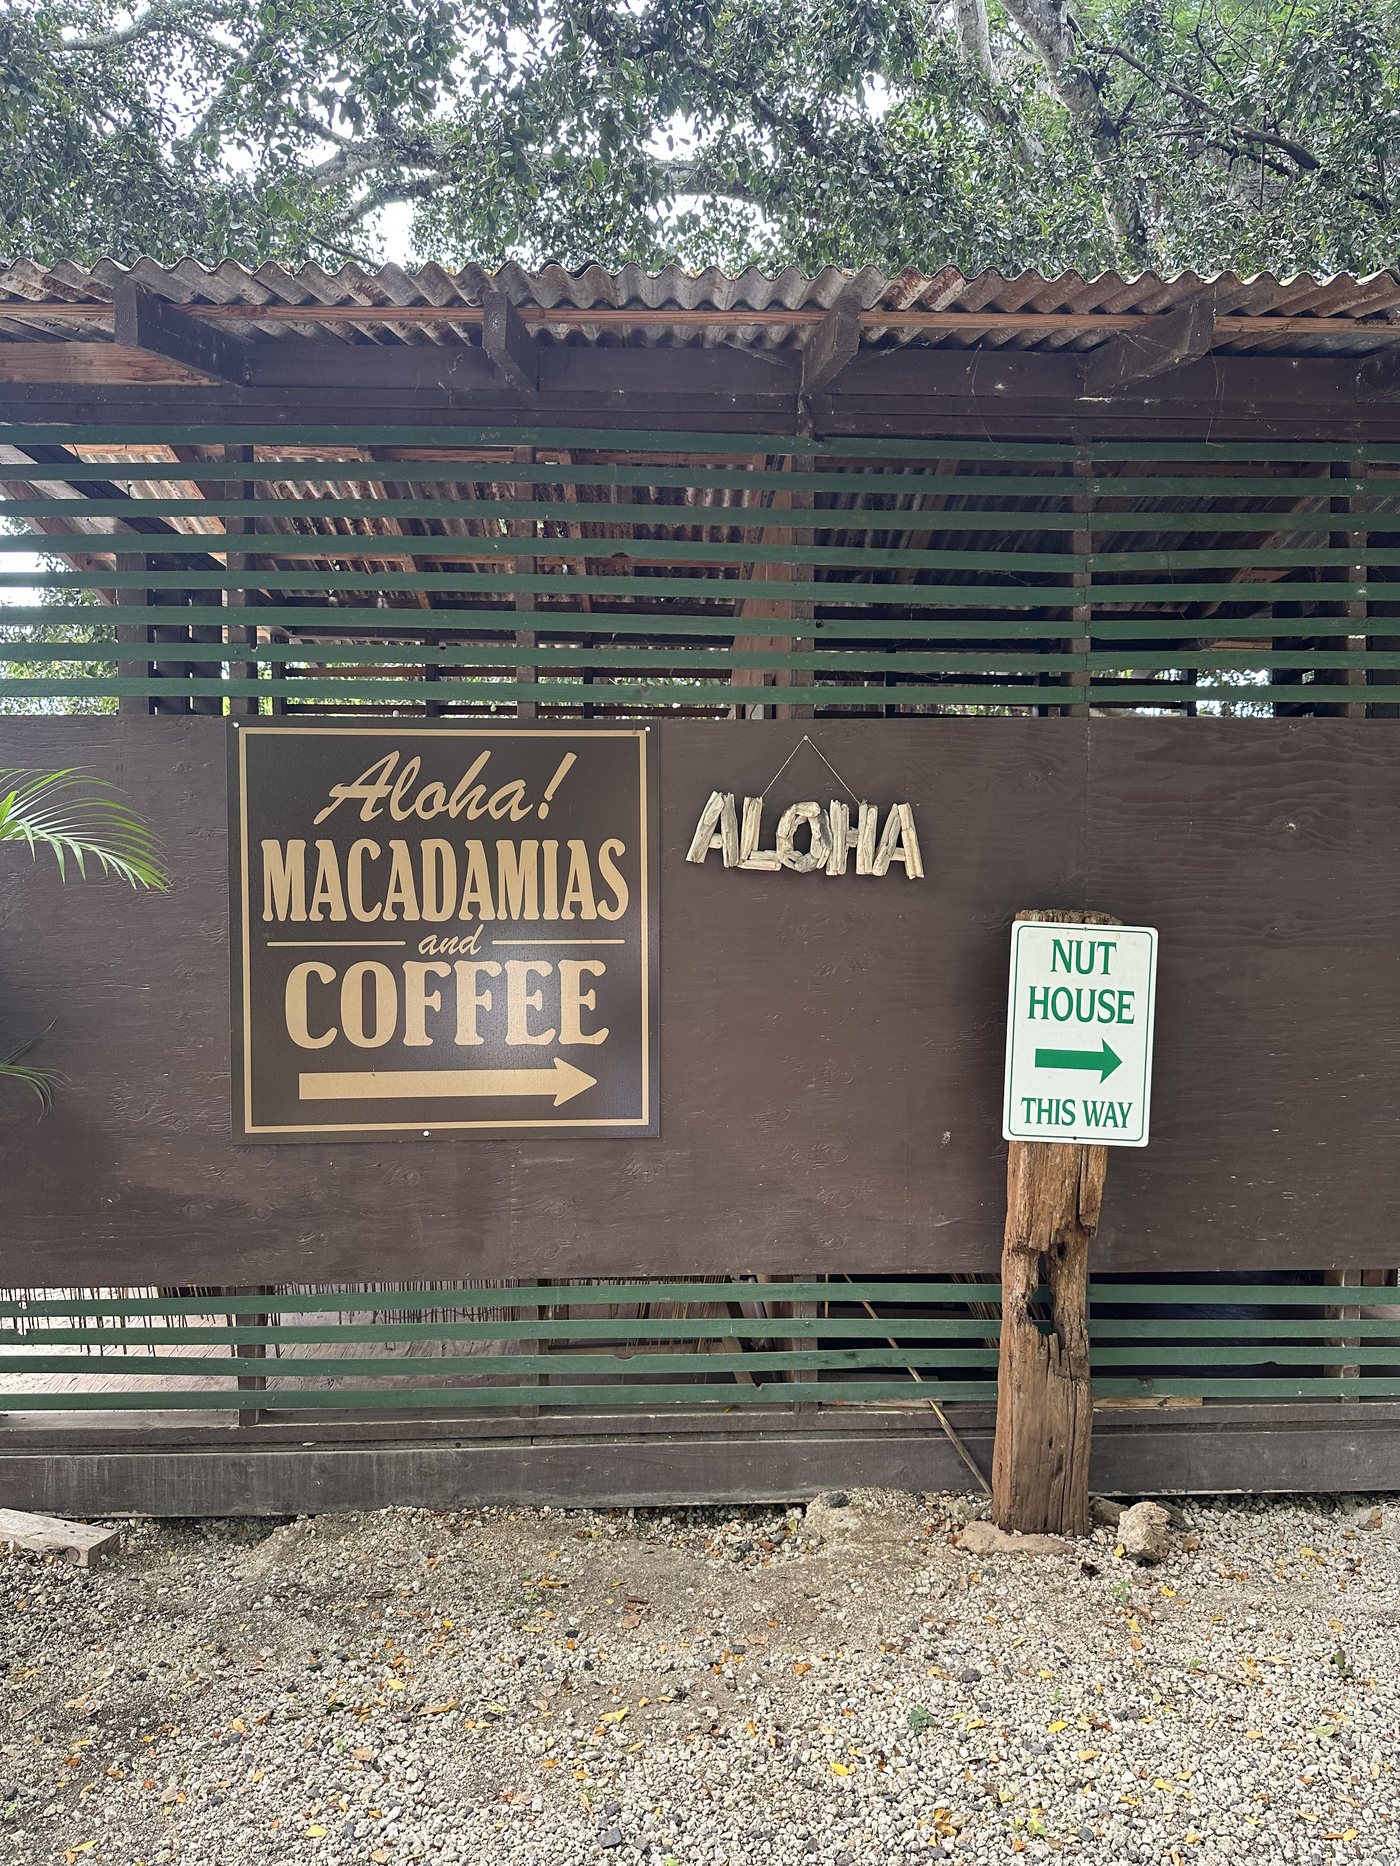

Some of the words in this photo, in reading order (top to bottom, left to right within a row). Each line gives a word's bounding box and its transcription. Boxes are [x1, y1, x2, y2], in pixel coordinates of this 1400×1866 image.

[313, 750, 577, 825] Aloha!
[685, 791, 925, 880] ALOHA
[261, 838, 630, 922] MACADAMIAS
[418, 924, 484, 955] and
[1050, 938, 1118, 976] NUT
[285, 959, 610, 1049] COFFEE
[1027, 985, 1136, 1025] HOUSE
[1021, 1097, 1076, 1127] THIS
[1082, 1100, 1133, 1129] WAY
